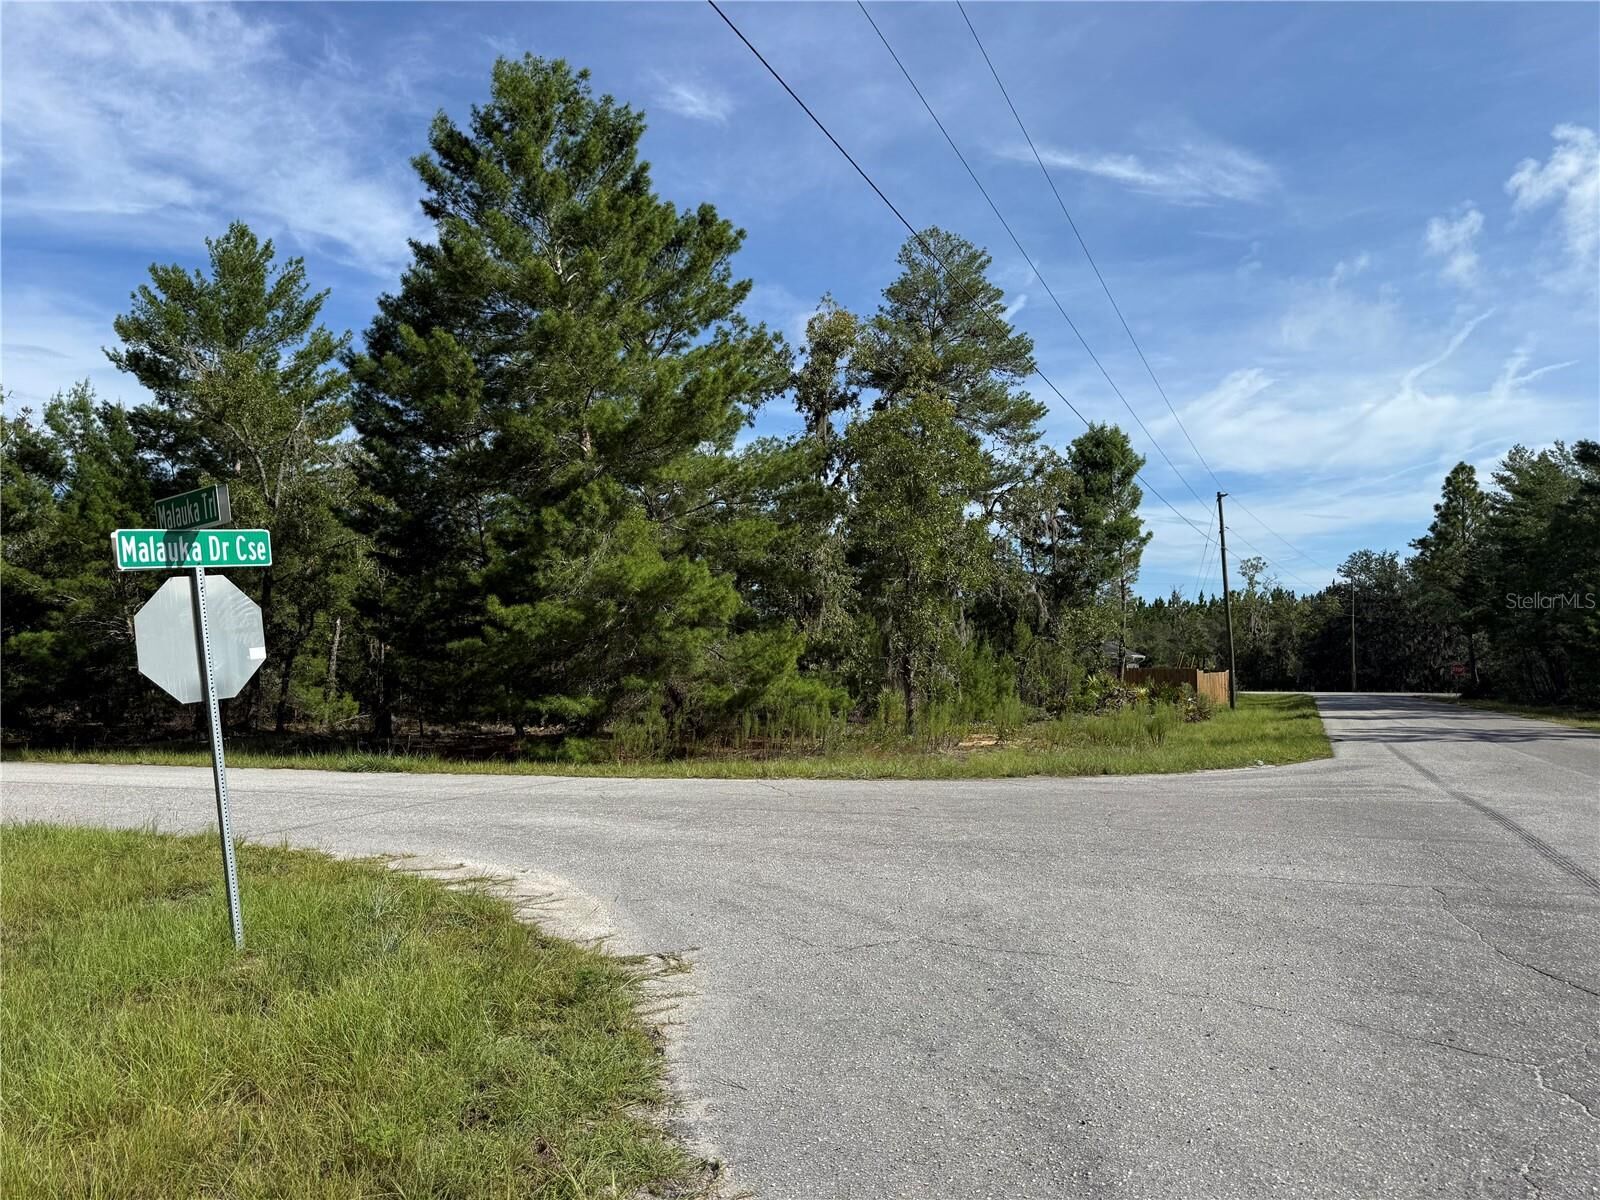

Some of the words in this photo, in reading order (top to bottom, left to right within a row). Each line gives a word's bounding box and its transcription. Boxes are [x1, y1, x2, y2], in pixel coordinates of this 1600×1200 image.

[158, 498, 200, 529] Malauka
[202, 489, 217, 520] Trl
[121, 536, 202, 562] Malauka
[208, 536, 229, 561] Dr
[236, 536, 266, 561] Cse
